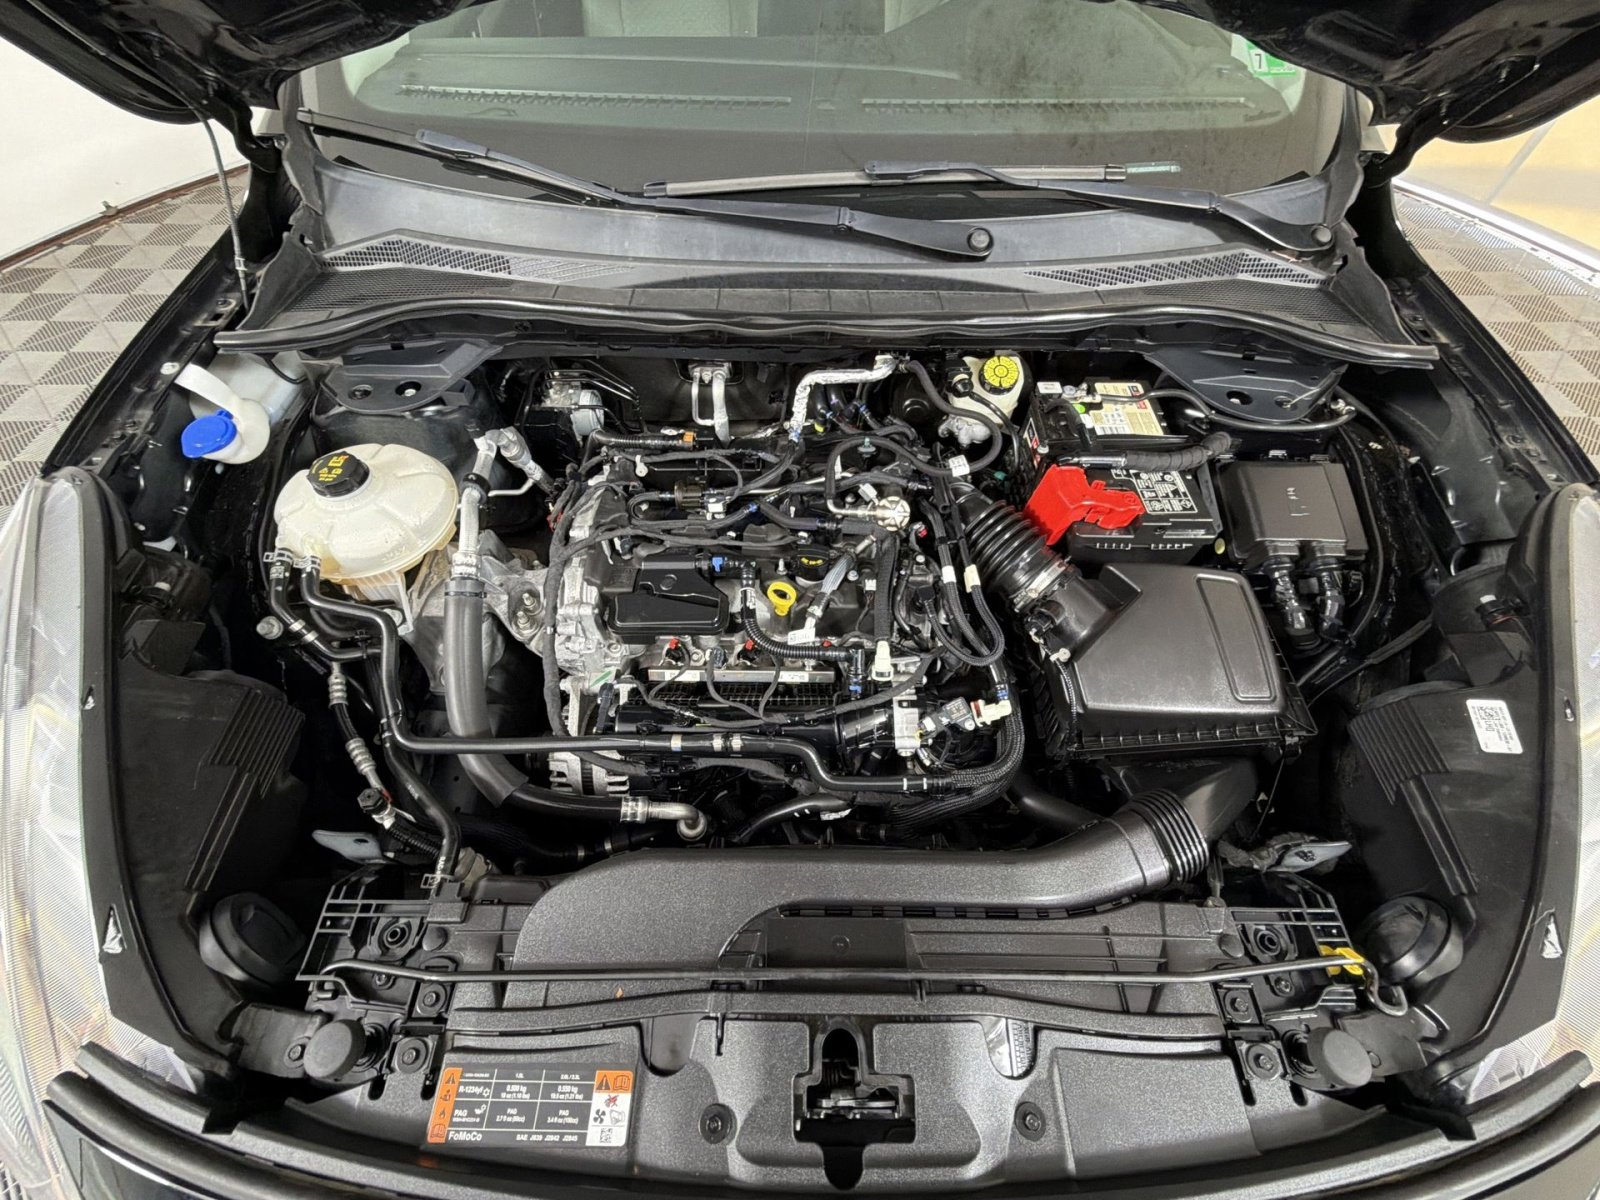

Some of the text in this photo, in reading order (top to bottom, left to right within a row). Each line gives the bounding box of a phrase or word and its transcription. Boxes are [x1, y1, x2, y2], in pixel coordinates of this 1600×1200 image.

[1254, 53, 1262, 70] 7
[453, 1109, 468, 1117] PAG
[448, 1131, 483, 1141] FoMoCo
